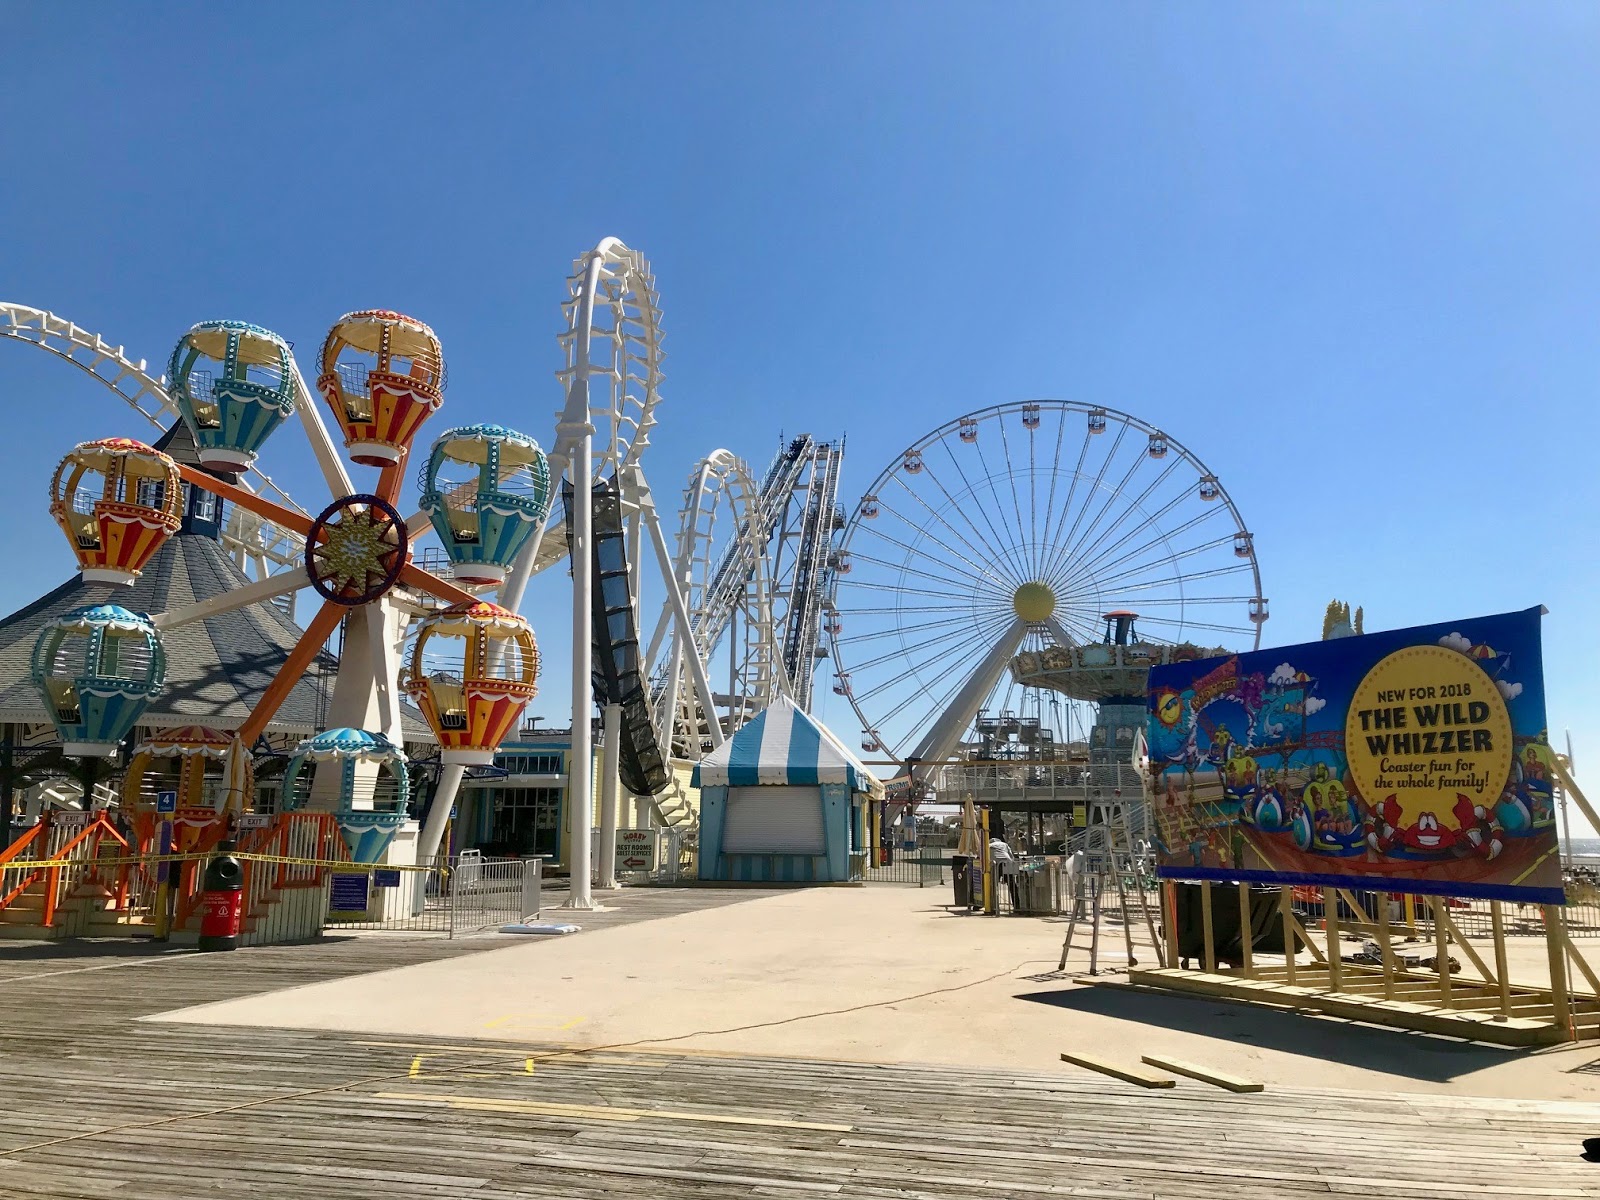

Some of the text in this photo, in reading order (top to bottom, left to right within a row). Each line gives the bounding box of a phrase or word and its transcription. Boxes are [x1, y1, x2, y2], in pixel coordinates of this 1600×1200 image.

[1377, 683, 1471, 703] NEW FOR 2018
[1358, 701, 1491, 731] THE WILD
[1365, 729, 1493, 757] WHIZZER
[1380, 757, 1476, 775] Coaster fun for
[1374, 771, 1490, 794] the whole family!
[162, 794, 170, 804] 4
